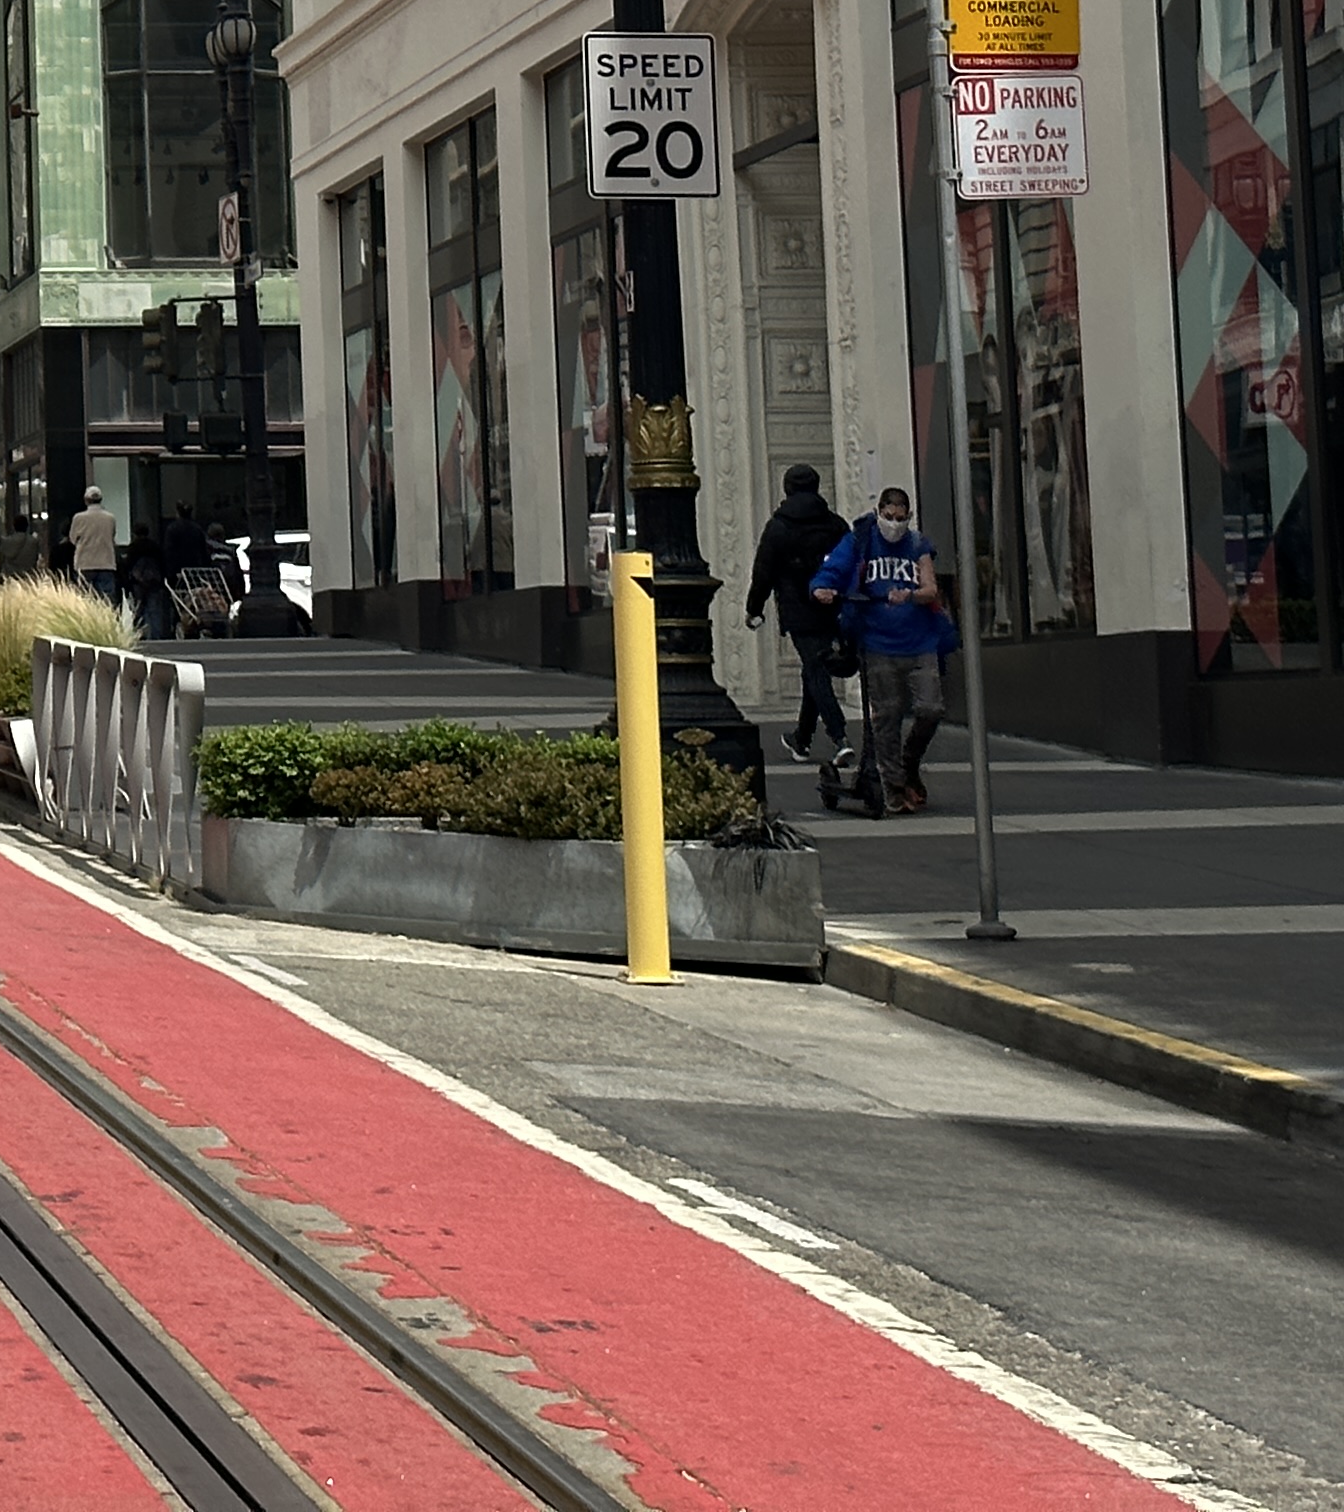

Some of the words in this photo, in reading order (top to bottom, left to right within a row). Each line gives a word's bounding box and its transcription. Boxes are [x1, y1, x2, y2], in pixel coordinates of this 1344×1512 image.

[968, 0, 1060, 13] COMMERCIAL
[985, 15, 1045, 27] LOADING
[992, 32, 1027, 41] MINUTE
[1029, 31, 1053, 40] LIMIT
[985, 43, 998, 51] AT
[999, 43, 1017, 51] ALL
[1018, 42, 1045, 51] TIMES
[597, 53, 704, 78] SPEED
[609, 87, 693, 111] LIMIT
[958, 80, 990, 111] NO
[1000, 86, 1077, 109] PARKING
[975, 119, 1009, 141] 2AM
[1035, 118, 1066, 140] 6AM
[604, 120, 703, 179] 20
[974, 143, 1069, 164] EVERYDAY
[978, 166, 1022, 176] INCLUDING
[1026, 165, 1068, 175] HOLIDAYS
[970, 180, 1014, 193] STREET
[1020, 178, 1079, 191] SWEEPING
